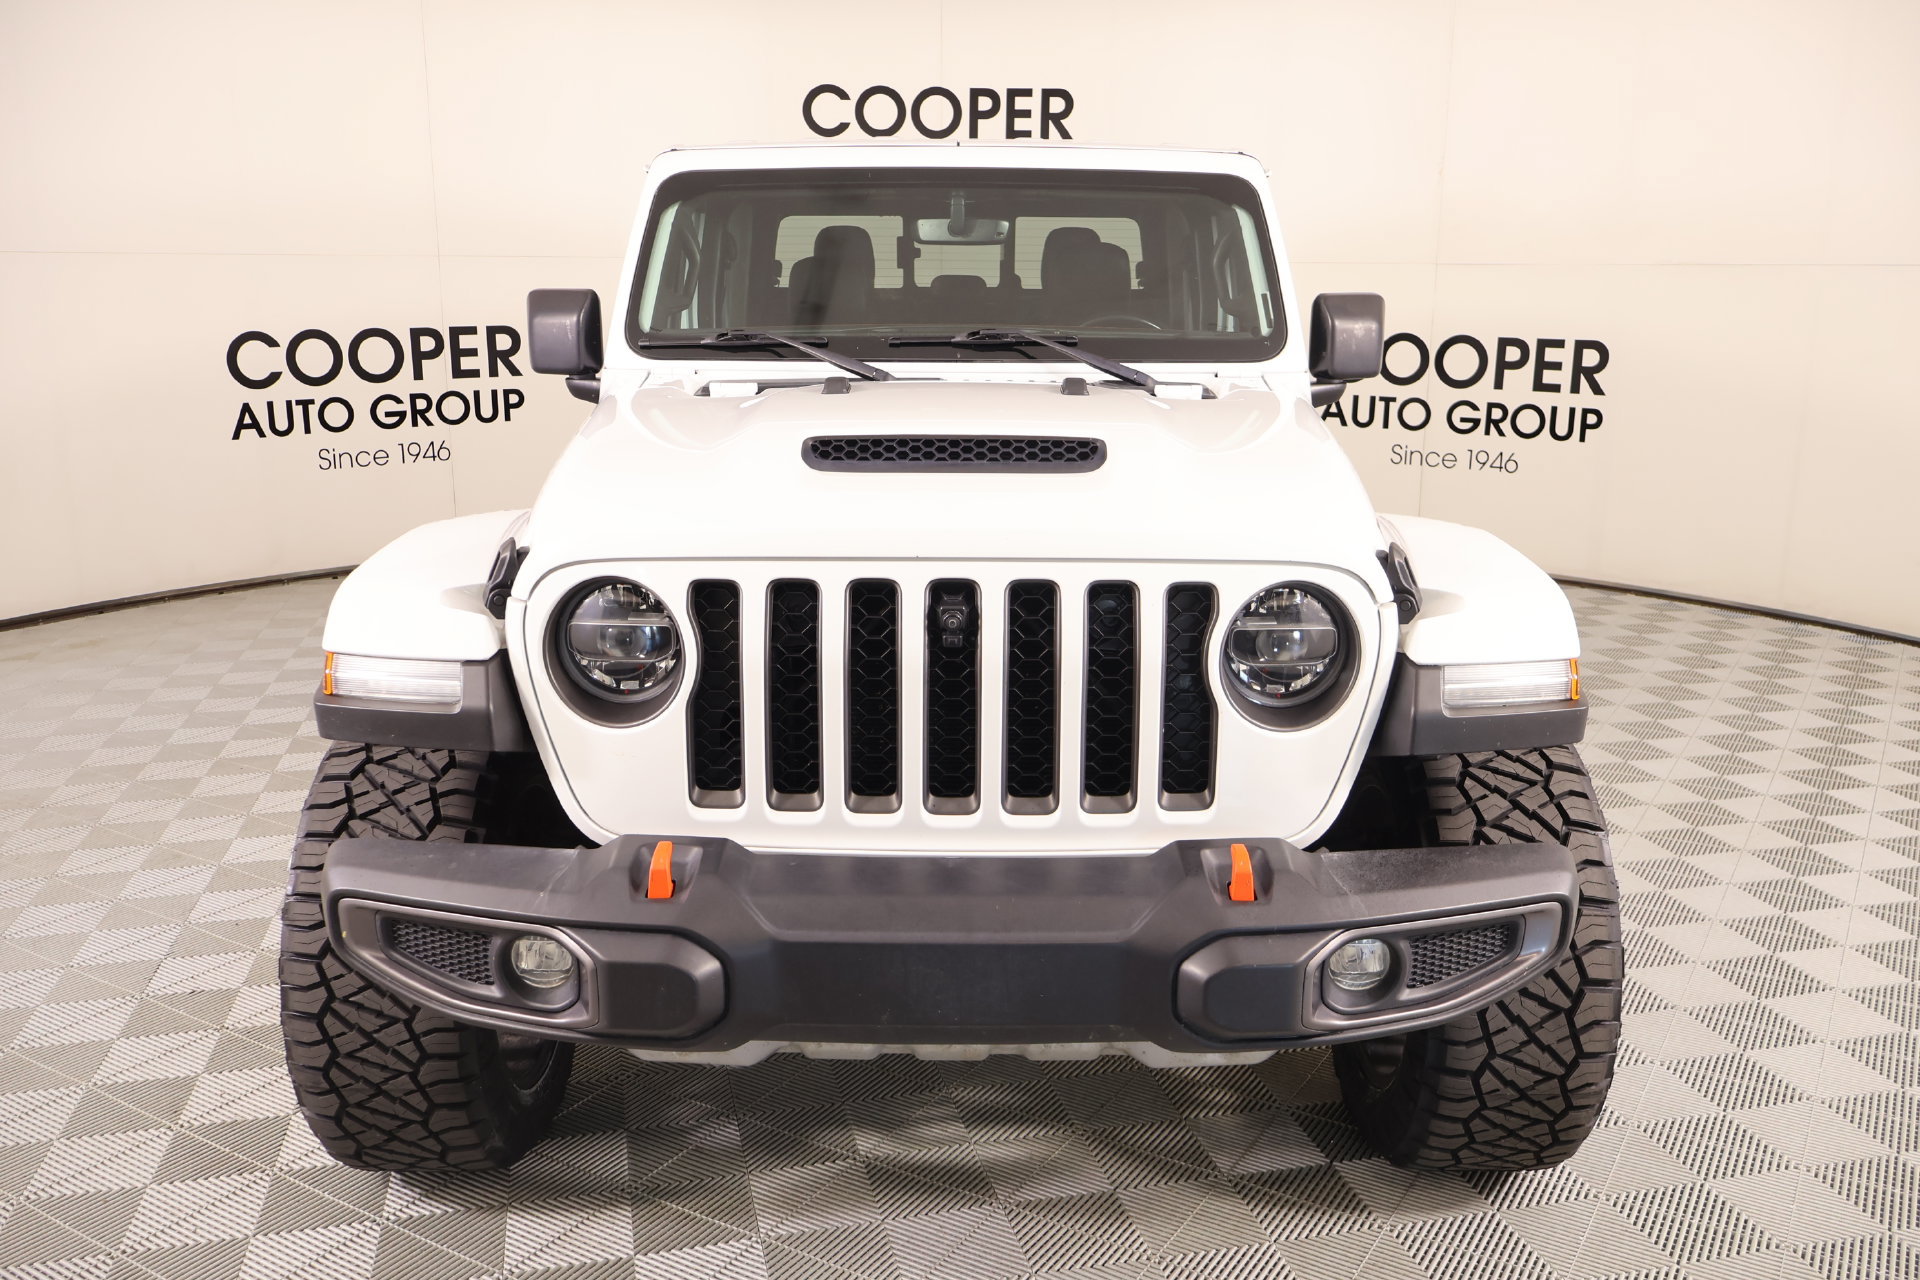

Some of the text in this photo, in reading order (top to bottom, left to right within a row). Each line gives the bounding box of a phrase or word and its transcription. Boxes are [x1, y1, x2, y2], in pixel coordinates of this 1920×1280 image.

[802, 83, 1075, 139] COOPER
[226, 325, 524, 390] COOPER
[1380, 332, 1610, 397] OOPER
[231, 388, 525, 441] AUTO GROUP
[1321, 394, 1604, 443] AUTO GROUP
[318, 440, 451, 471] Since 1946
[1390, 443, 1519, 474] Since 1946
